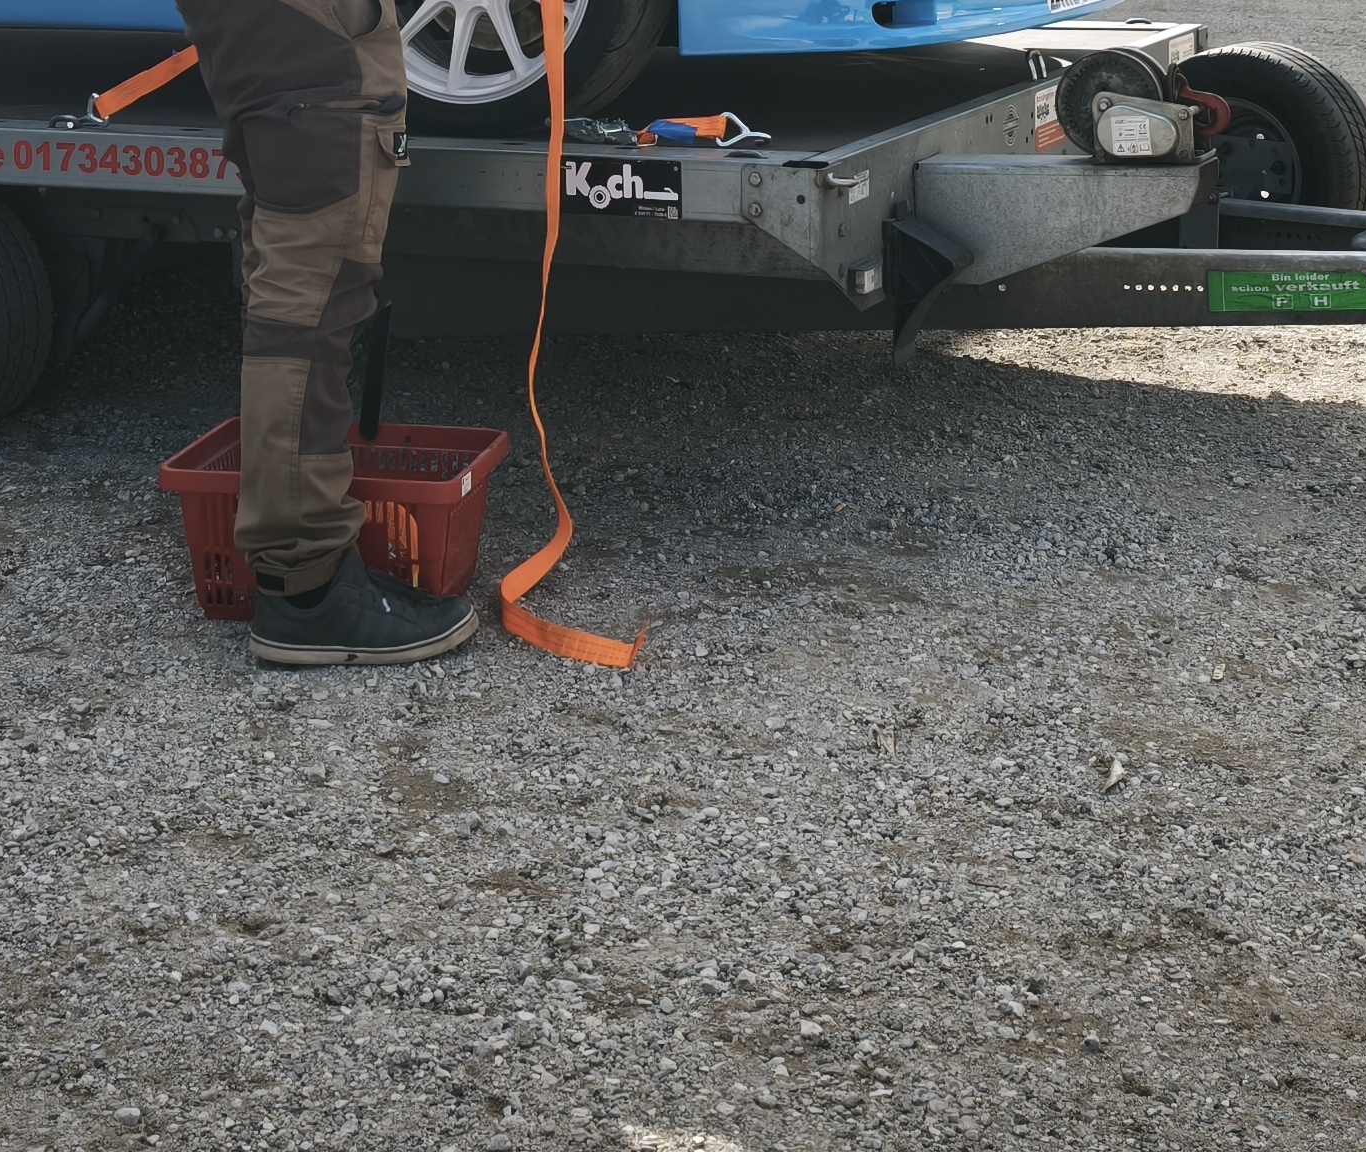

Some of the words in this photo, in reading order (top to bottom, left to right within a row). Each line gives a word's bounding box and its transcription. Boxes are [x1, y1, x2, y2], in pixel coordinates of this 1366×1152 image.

[13, 138, 244, 181] 0173430387
[565, 160, 645, 210] Koch
[1232, 285, 1270, 293] schon
[1274, 279, 1361, 294] verkauft
[1271, 272, 1292, 282] Bin
[1294, 272, 1330, 282] leider
